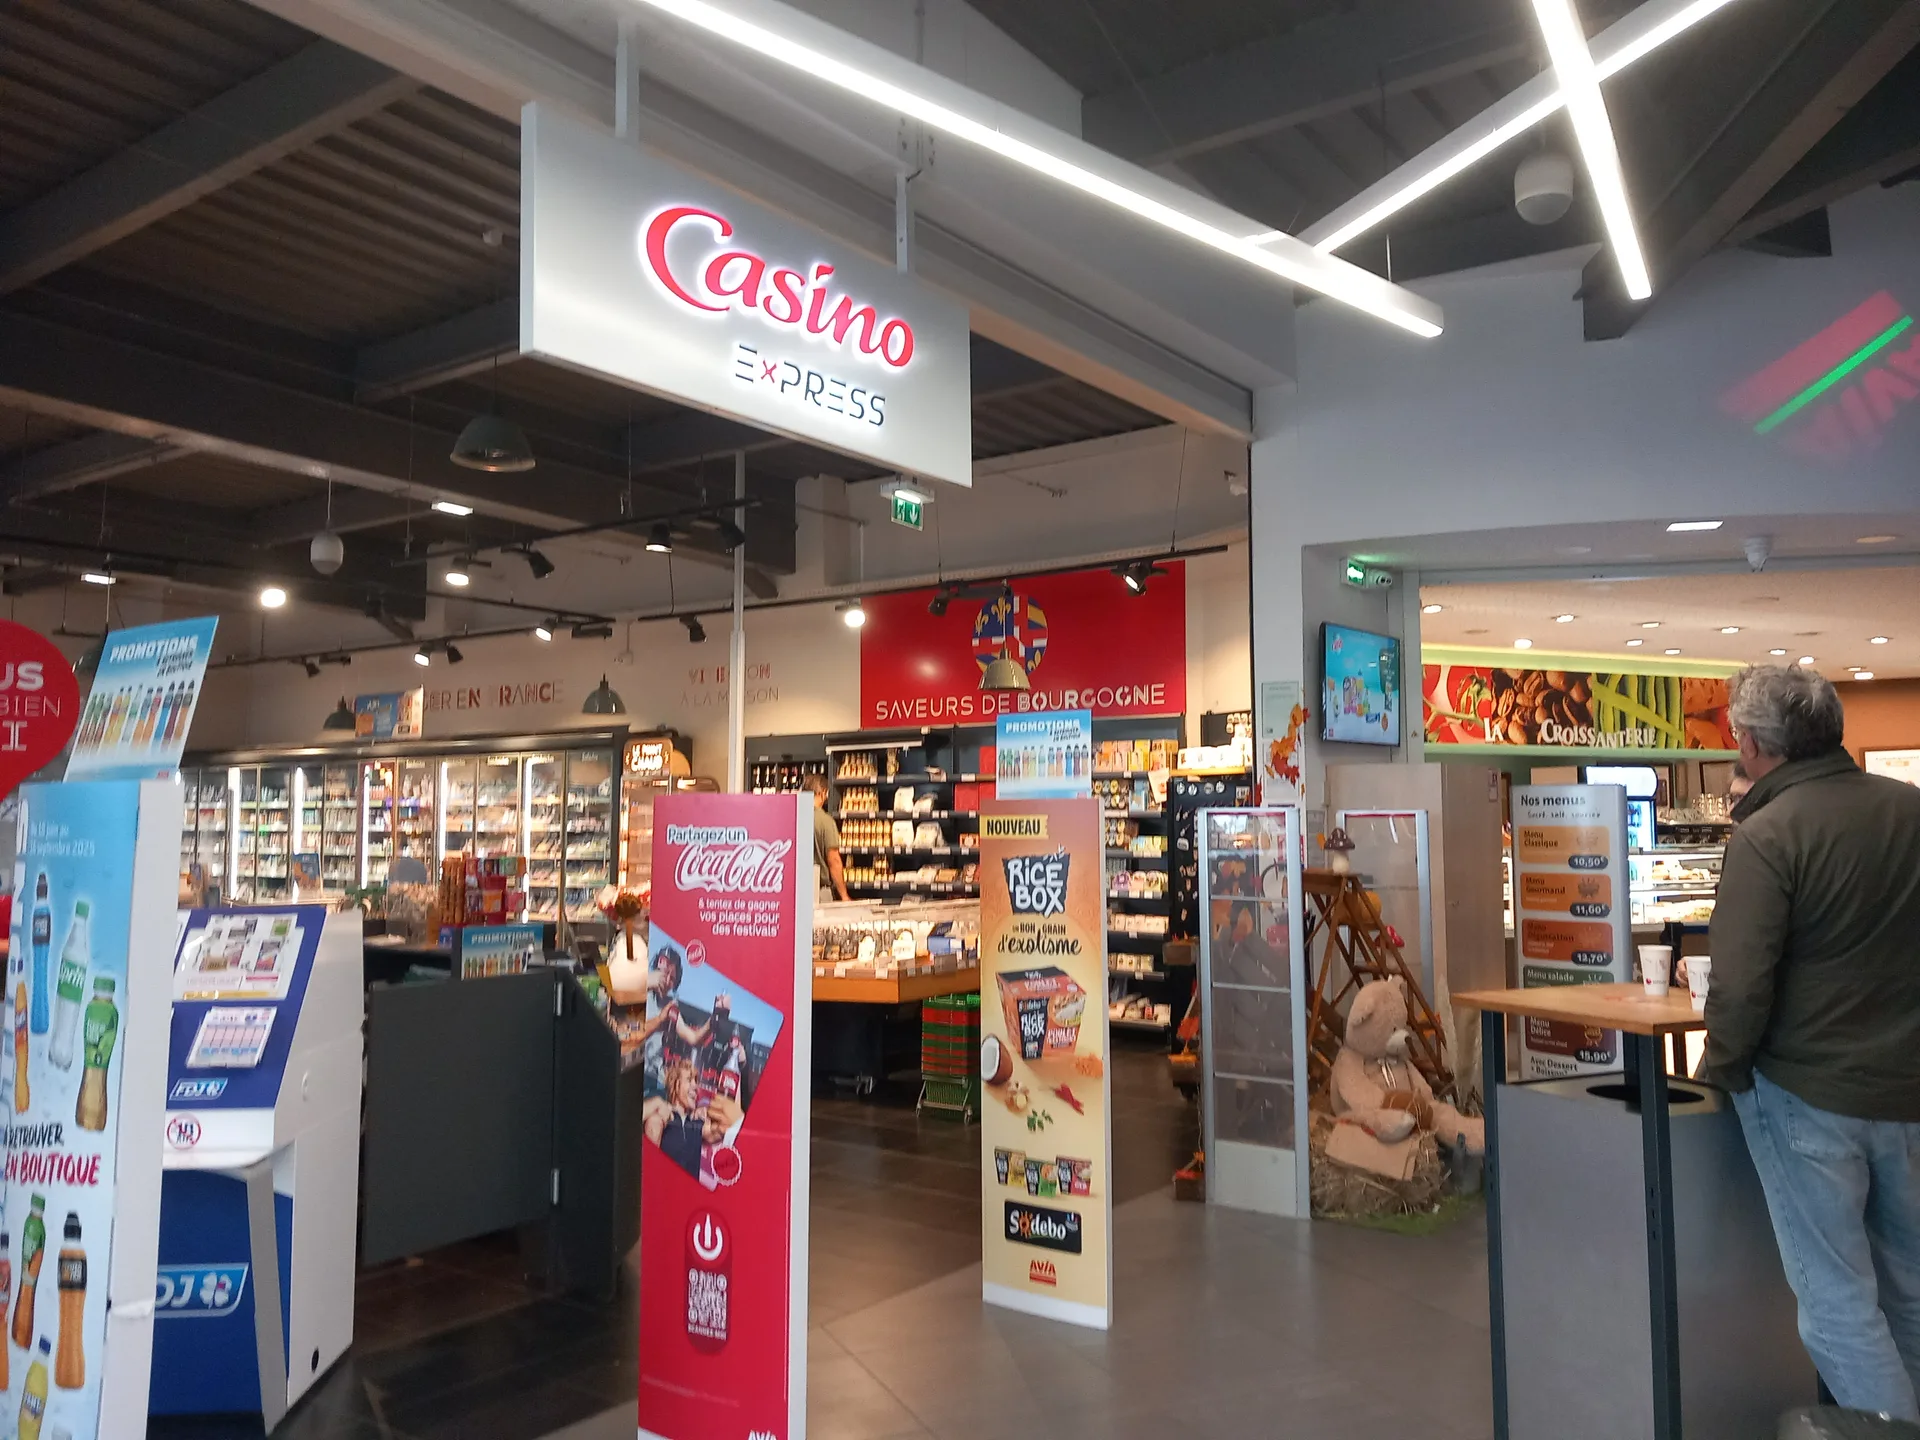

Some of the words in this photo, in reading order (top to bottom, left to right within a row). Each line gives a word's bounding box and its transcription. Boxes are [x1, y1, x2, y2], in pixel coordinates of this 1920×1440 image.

[646, 207, 914, 367] Casino
[110, 634, 199, 664] PROMOTIONS
[456, 686, 481, 709] EN
[876, 696, 974, 720] SAVEURS
[982, 694, 1010, 716] DE
[1017, 683, 1166, 714] BOURGOGNE
[1005, 719, 1081, 734] PROMOTIONS
[1483, 717, 1504, 742] LA
[1521, 794, 1540, 806] Nos
[1543, 796, 1586, 806] menus
[668, 825, 724, 845] Partagez
[727, 828, 747, 843] un
[986, 818, 1041, 836] NOUVEAU
[676, 839, 792, 893] Coca-Cola
[1007, 857, 1064, 893] RICE
[707, 898, 732, 909] tentez
[734, 898, 745, 909] de
[748, 900, 780, 912] gagner
[1015, 884, 1064, 918] BOX
[700, 911, 716, 922] vos
[719, 909, 751, 923] places
[754, 912, 780, 924] pour
[712, 923, 730, 936] des
[998, 929, 1083, 956] d'exotisme
[20, 1150, 101, 1187] BOUTIQUE
[1030, 1259, 1056, 1275] AVIA
